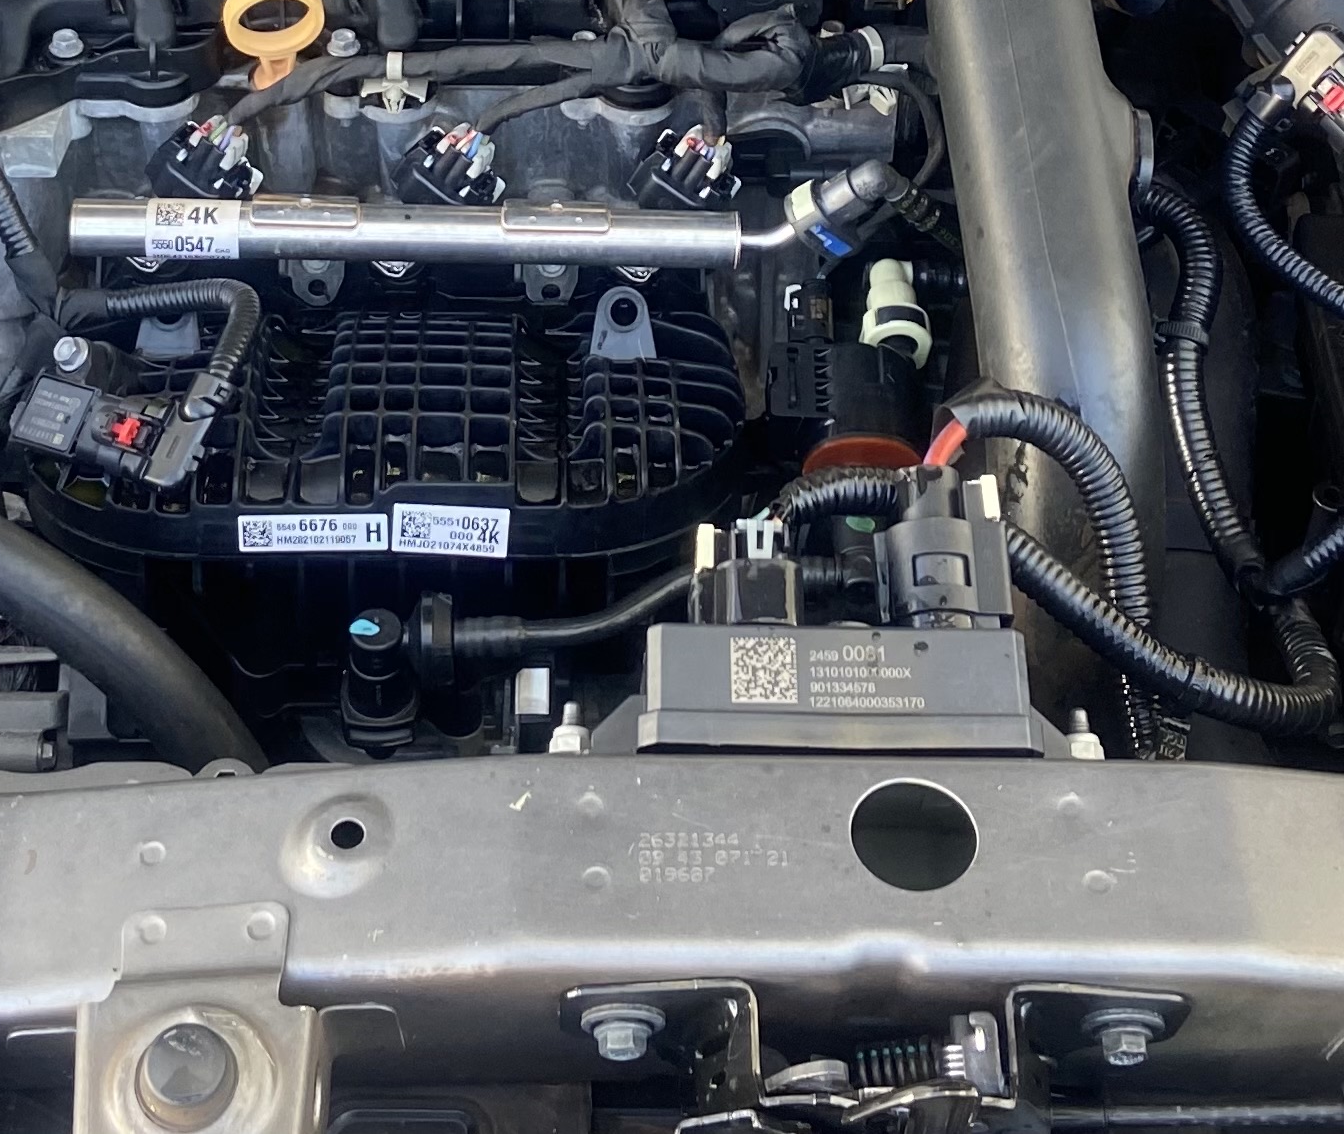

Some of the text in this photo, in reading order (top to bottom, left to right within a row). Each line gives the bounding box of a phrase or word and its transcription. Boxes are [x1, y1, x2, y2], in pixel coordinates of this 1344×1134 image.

[187, 206, 218, 224] 4K
[175, 235, 215, 253] 0547
[299, 519, 338, 532] 6676
[365, 522, 382, 542] H
[462, 516, 499, 532] 0637
[449, 530, 473, 541] 000
[809, 649, 839, 662] 2459
